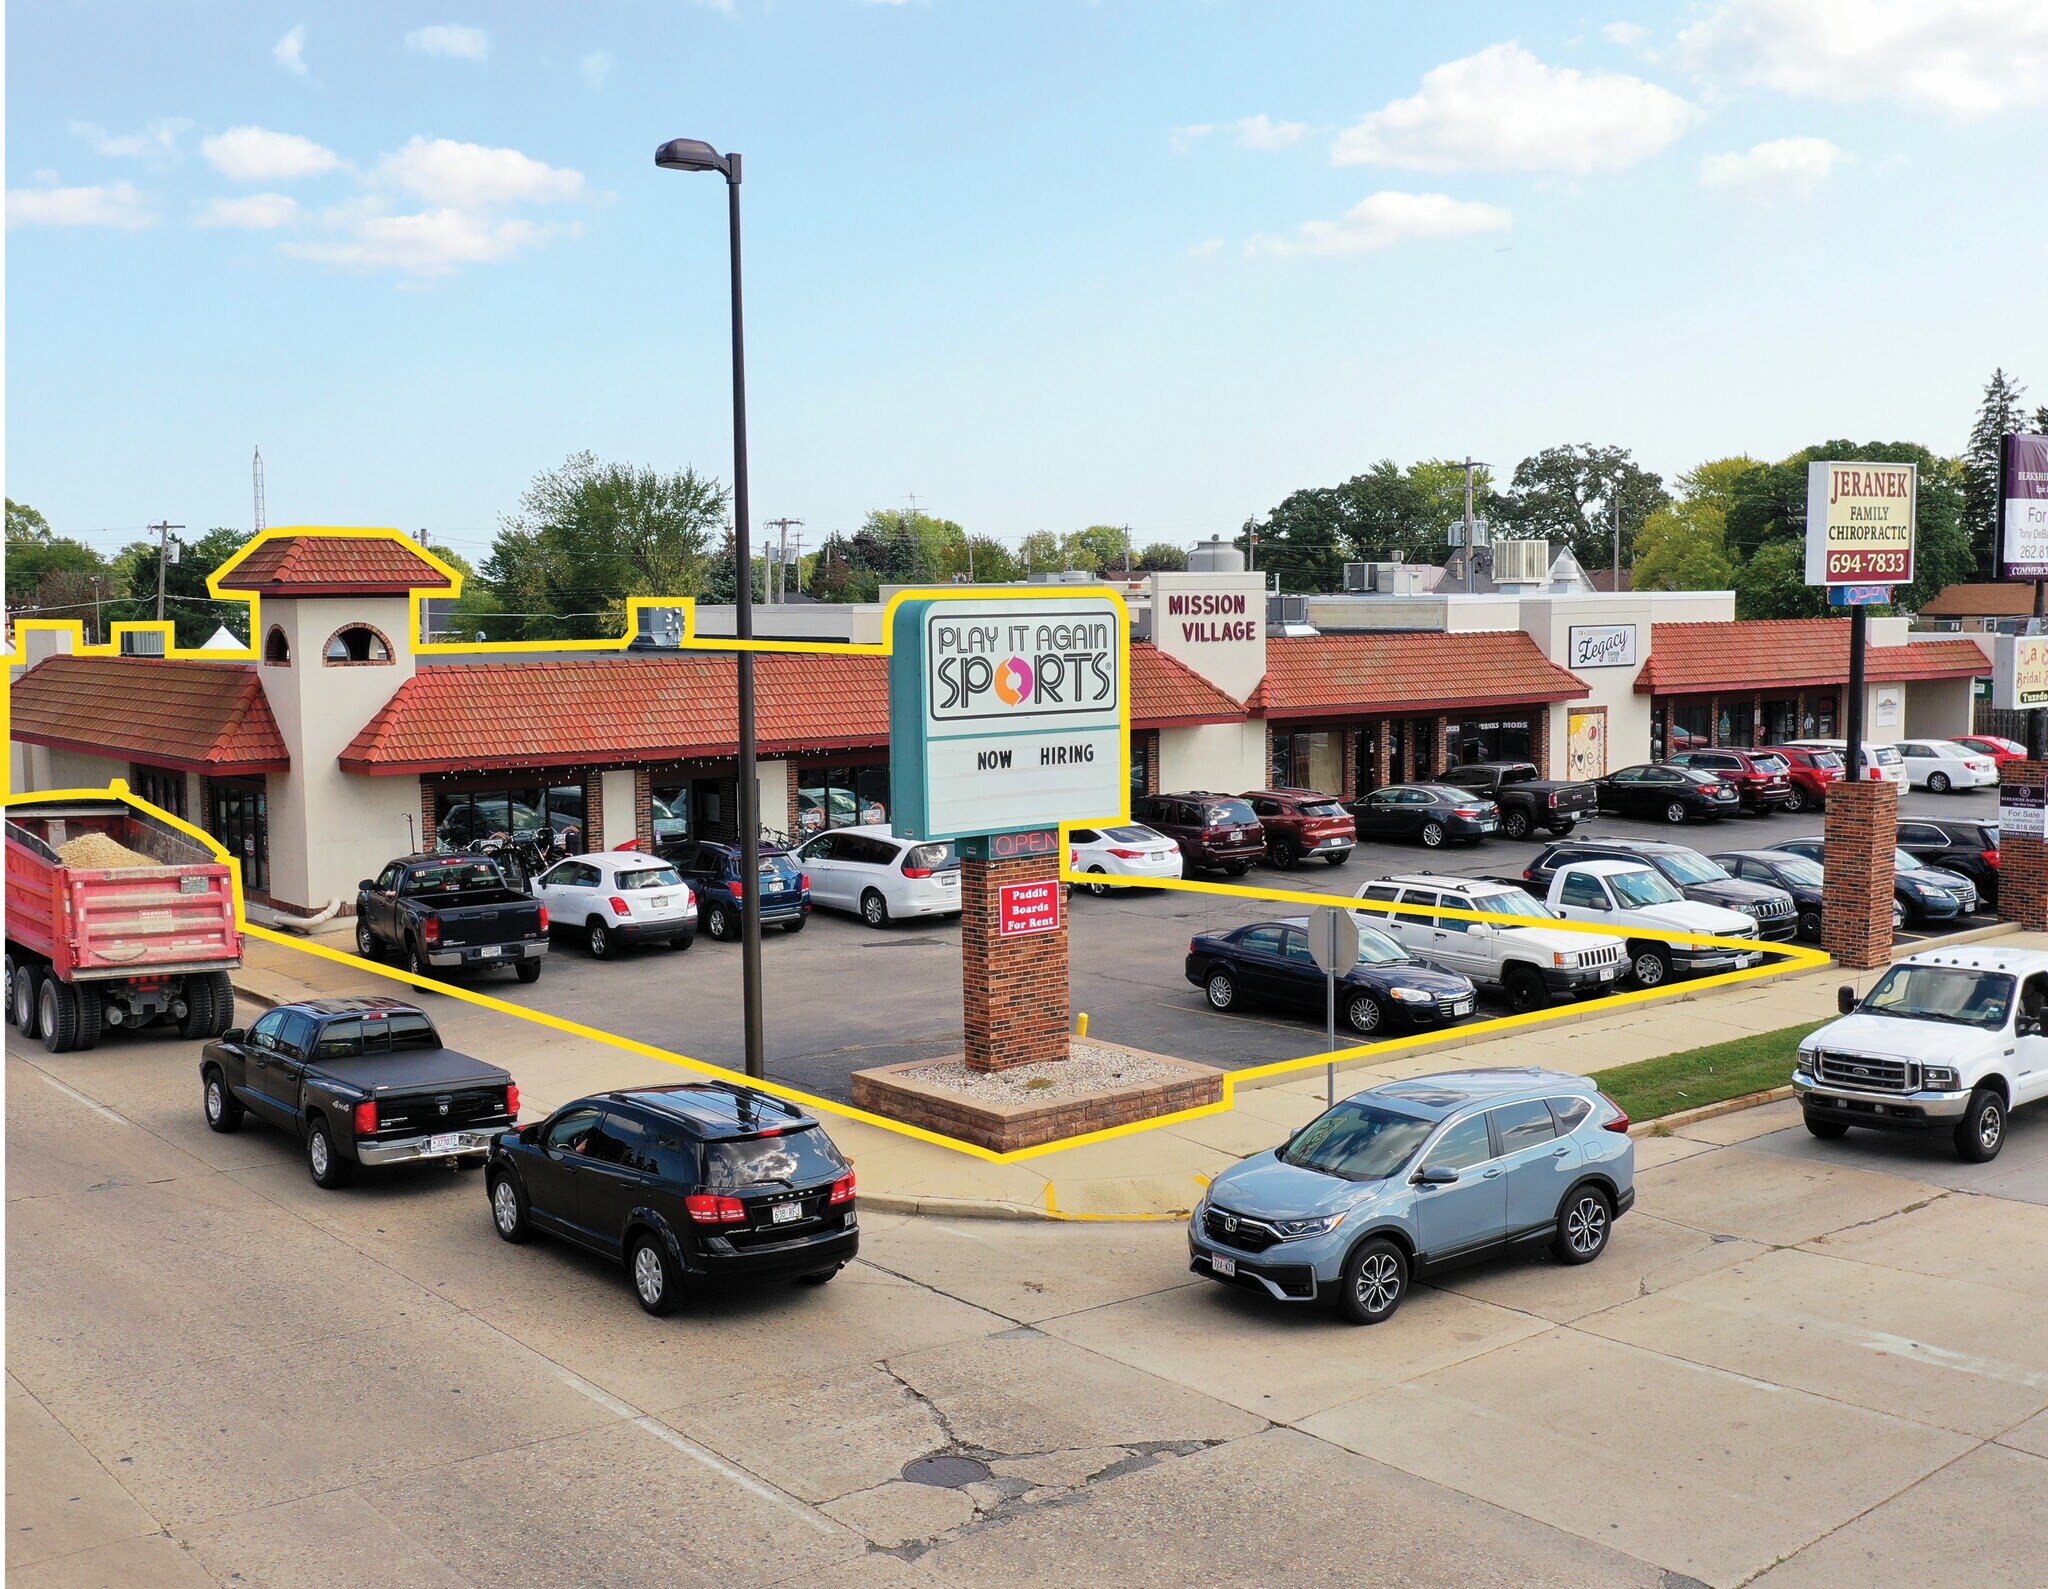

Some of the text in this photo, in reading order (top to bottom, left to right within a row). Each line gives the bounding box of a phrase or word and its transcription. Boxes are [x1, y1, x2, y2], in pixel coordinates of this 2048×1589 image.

[1831, 471, 1908, 504] JERANEK
[1850, 506, 1889, 521] FAMILY
[2028, 507, 2047, 522] For
[1828, 525, 1907, 540] CHIROPRACTIC
[1829, 553, 1905, 573] 694-7833
[1848, 586, 1890, 605] OPEN
[1168, 594, 1245, 615] MISSION
[938, 623, 1107, 654] PLAY IT AGAIN
[1182, 621, 1256, 642] VILLAGE
[1578, 630, 1628, 663] Legacy
[2016, 671, 2041, 688] Bridal
[2022, 691, 2048, 702] Tuxedo
[977, 744, 1094, 770] NOW HIRING
[2023, 810, 2040, 818] Sale
[996, 831, 1058, 855] OPEN
[1012, 888, 1048, 900] Paddle
[1012, 902, 1049, 915] Boards
[1007, 917, 1053, 930] For Rent
[332, 1101, 350, 1112] 4x4
